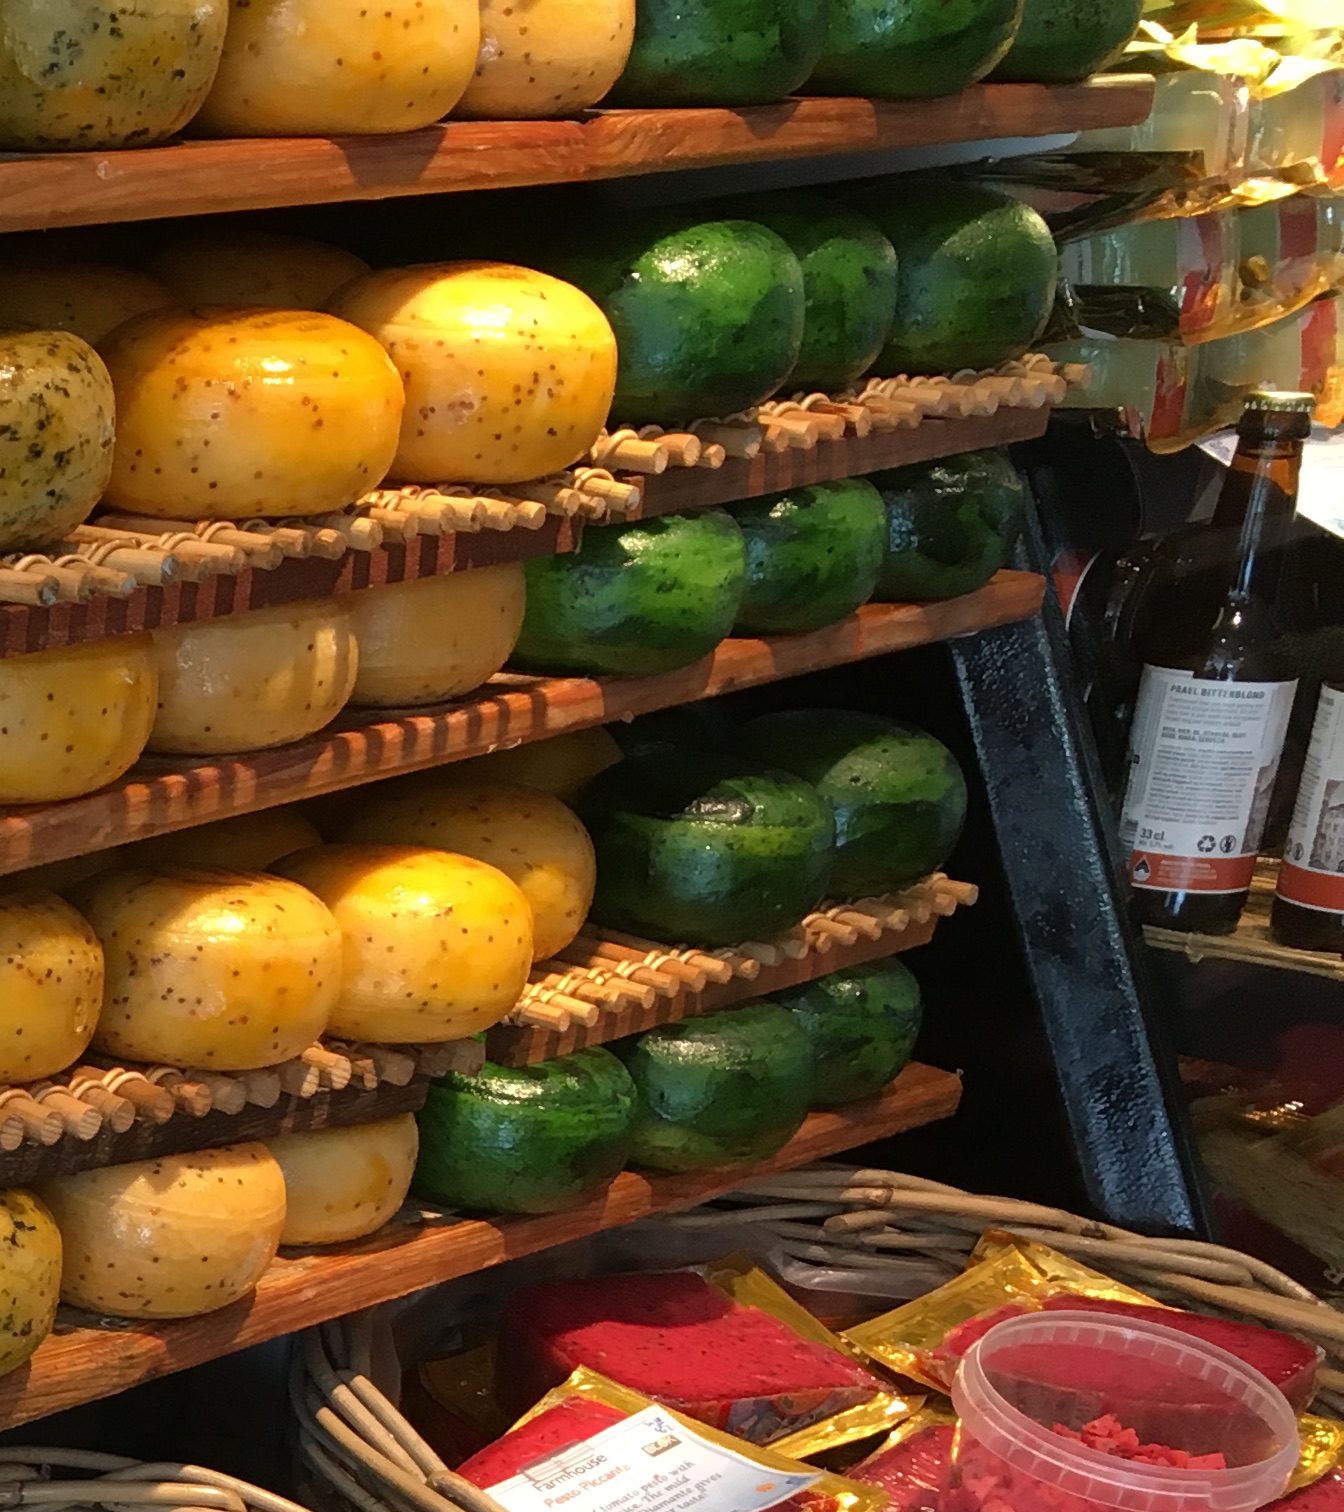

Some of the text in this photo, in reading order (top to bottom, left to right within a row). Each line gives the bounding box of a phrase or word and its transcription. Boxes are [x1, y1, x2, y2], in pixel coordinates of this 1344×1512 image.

[532, 1454, 608, 1492] Farmhouse
[543, 1464, 631, 1508] Pesto Piccante
[640, 1475, 668, 1492] pesto
[668, 1460, 696, 1477] with
[641, 1489, 664, 1503] The
[664, 1474, 691, 1492] mild
[694, 1472, 722, 1491] gives
